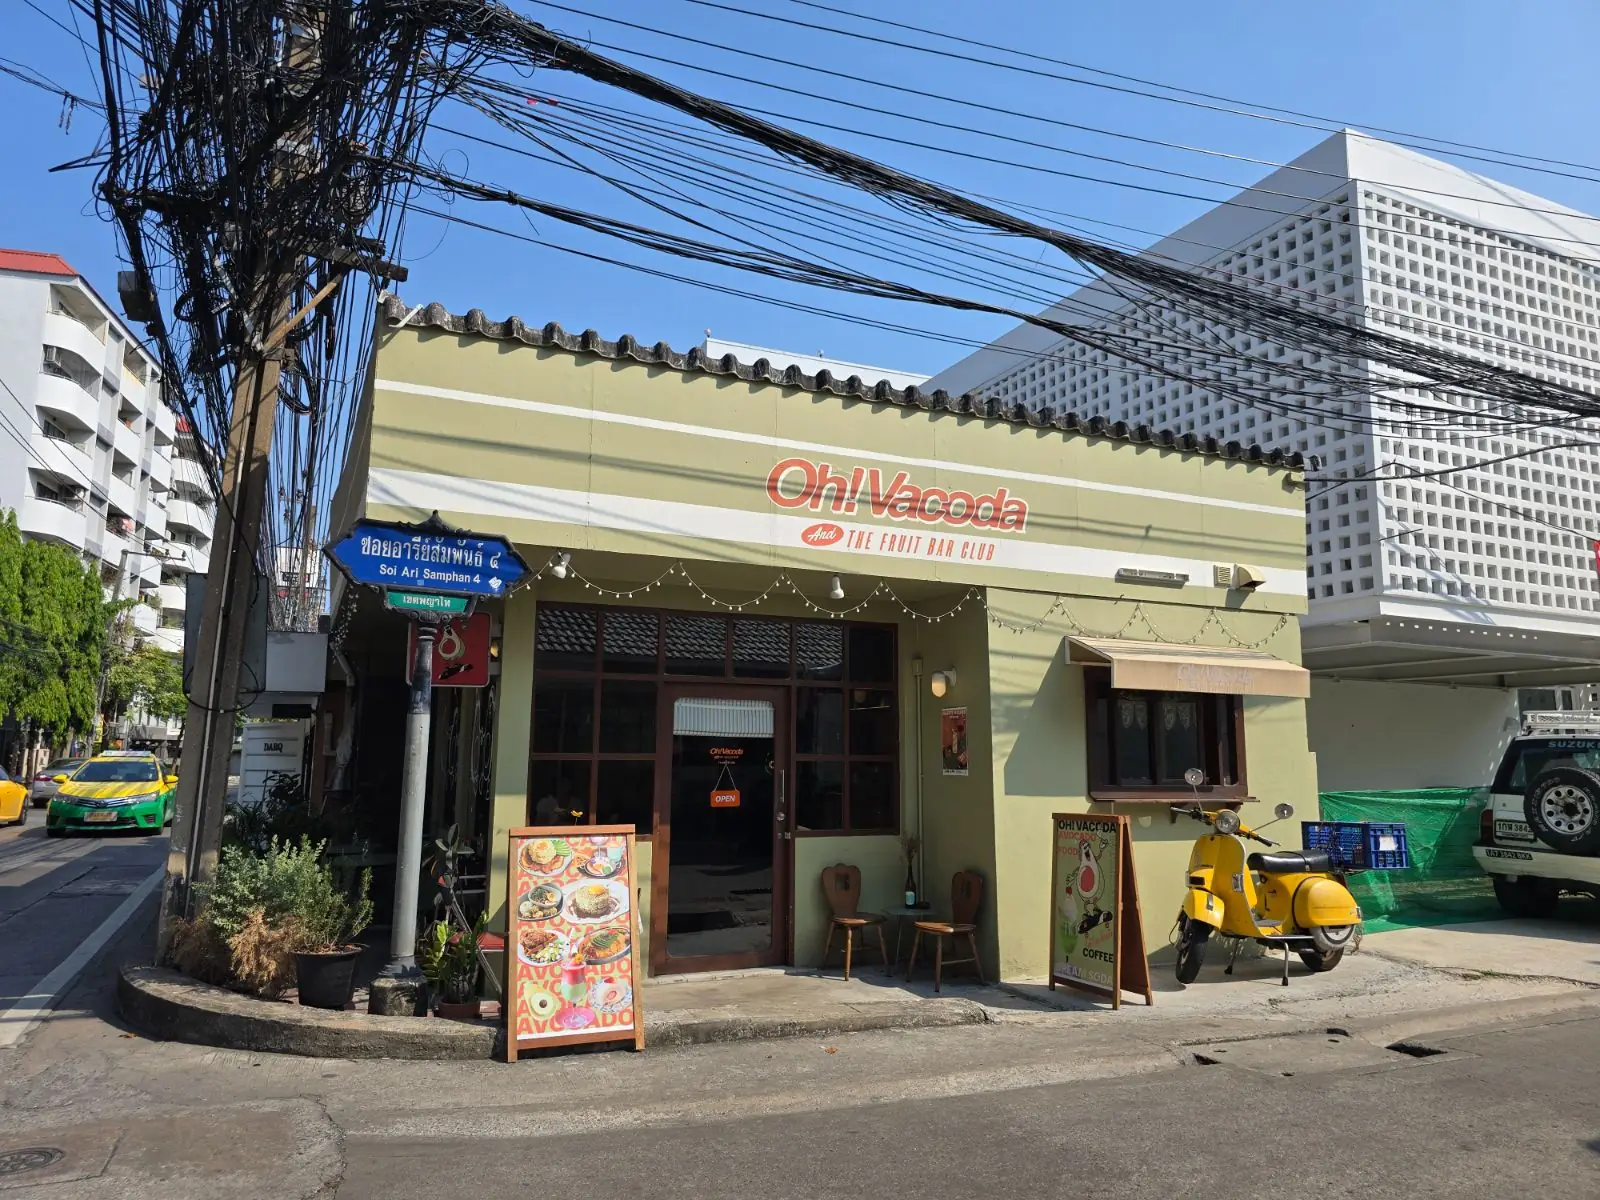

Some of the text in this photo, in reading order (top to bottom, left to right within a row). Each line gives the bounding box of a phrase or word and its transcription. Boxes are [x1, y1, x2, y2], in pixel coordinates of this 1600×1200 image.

[807, 526, 995, 561] And THE FRUIT BAR CLUB
[380, 564, 481, 584] Soi Ari Samphan 4
[402, 595, 451, 608] เขตพญาไท
[715, 795, 736, 803] OPEN
[1083, 947, 1114, 963] COFFEE
